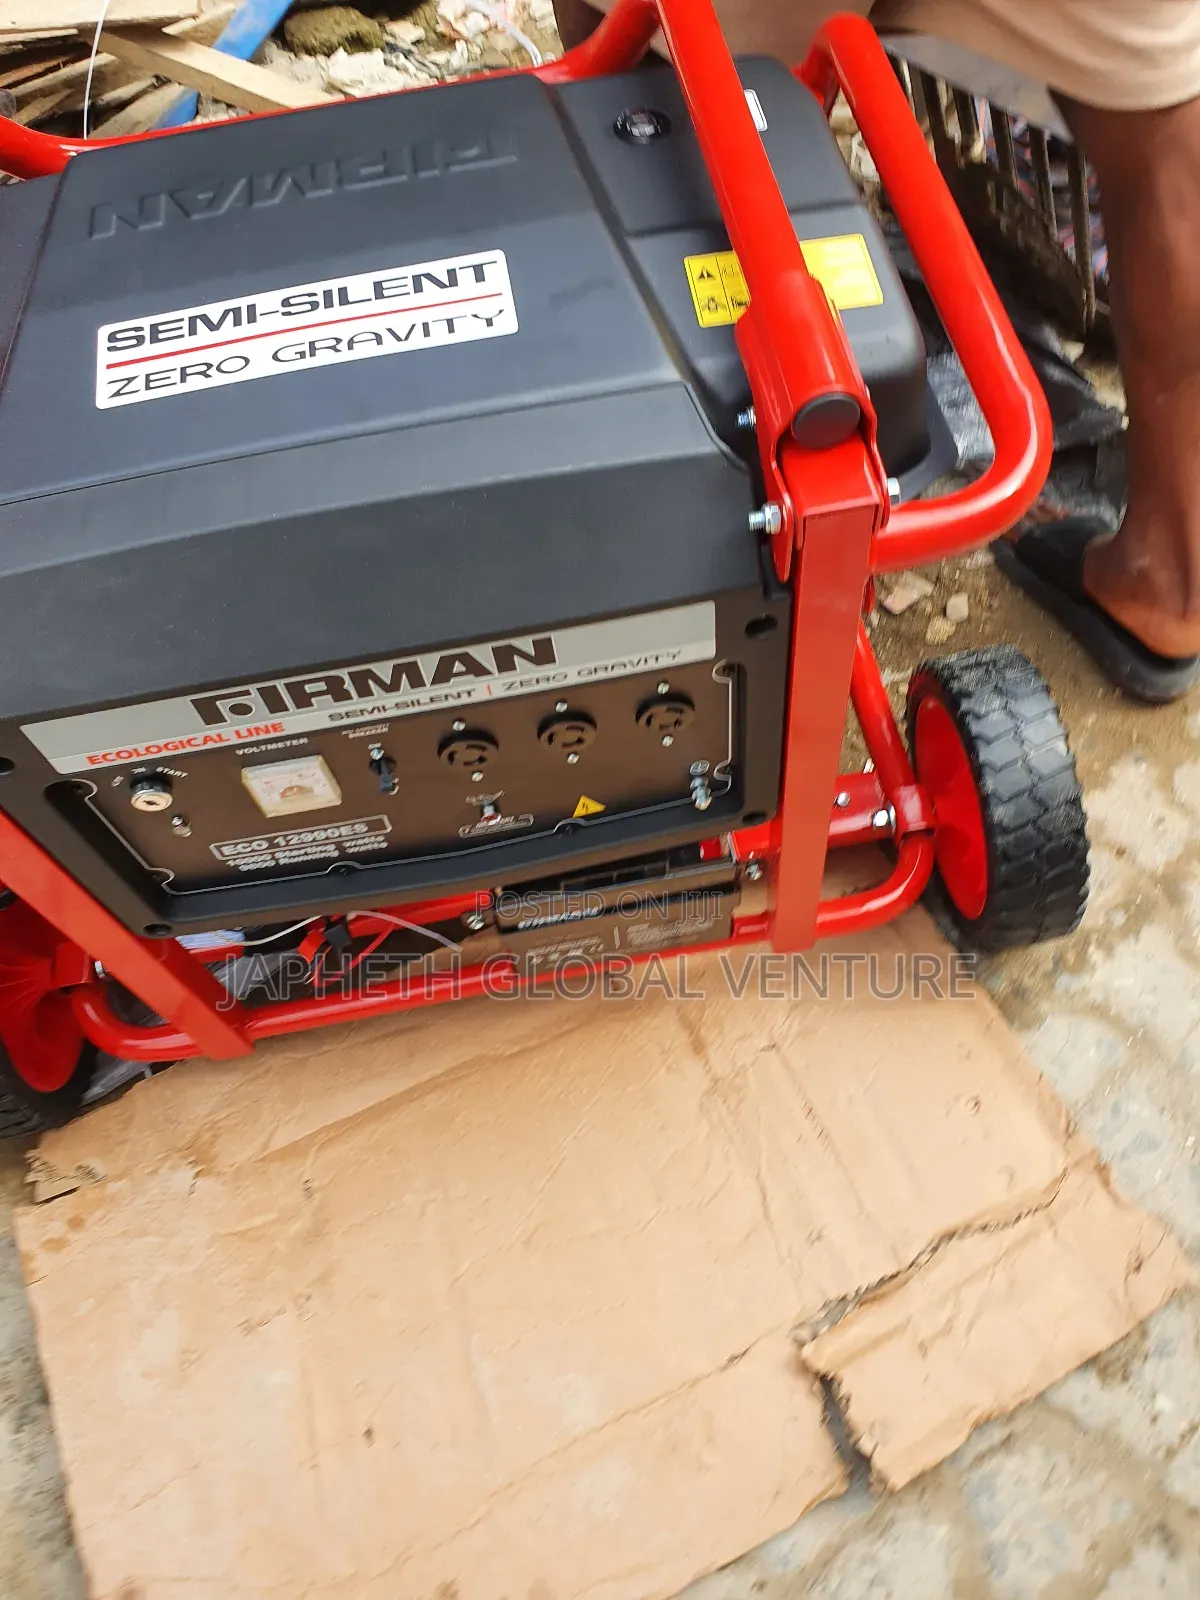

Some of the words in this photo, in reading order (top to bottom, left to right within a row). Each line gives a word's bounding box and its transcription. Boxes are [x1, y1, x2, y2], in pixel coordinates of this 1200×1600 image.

[89, 135, 517, 239] FIRMAN
[107, 260, 498, 352] SEMI-SILENT
[107, 355, 250, 400] ZERO
[272, 308, 504, 363] GRAVITY
[190, 635, 557, 727] FIRMAN
[328, 687, 477, 722] SEMI-SILENT
[501, 671, 568, 692] ZERO
[577, 650, 682, 678] GRAVITY
[87, 733, 230, 766] ECOLOGICAL
[235, 721, 286, 741] LINE
[235, 738, 309, 756] VOLTMETER
[220, 839, 269, 856] ECO
